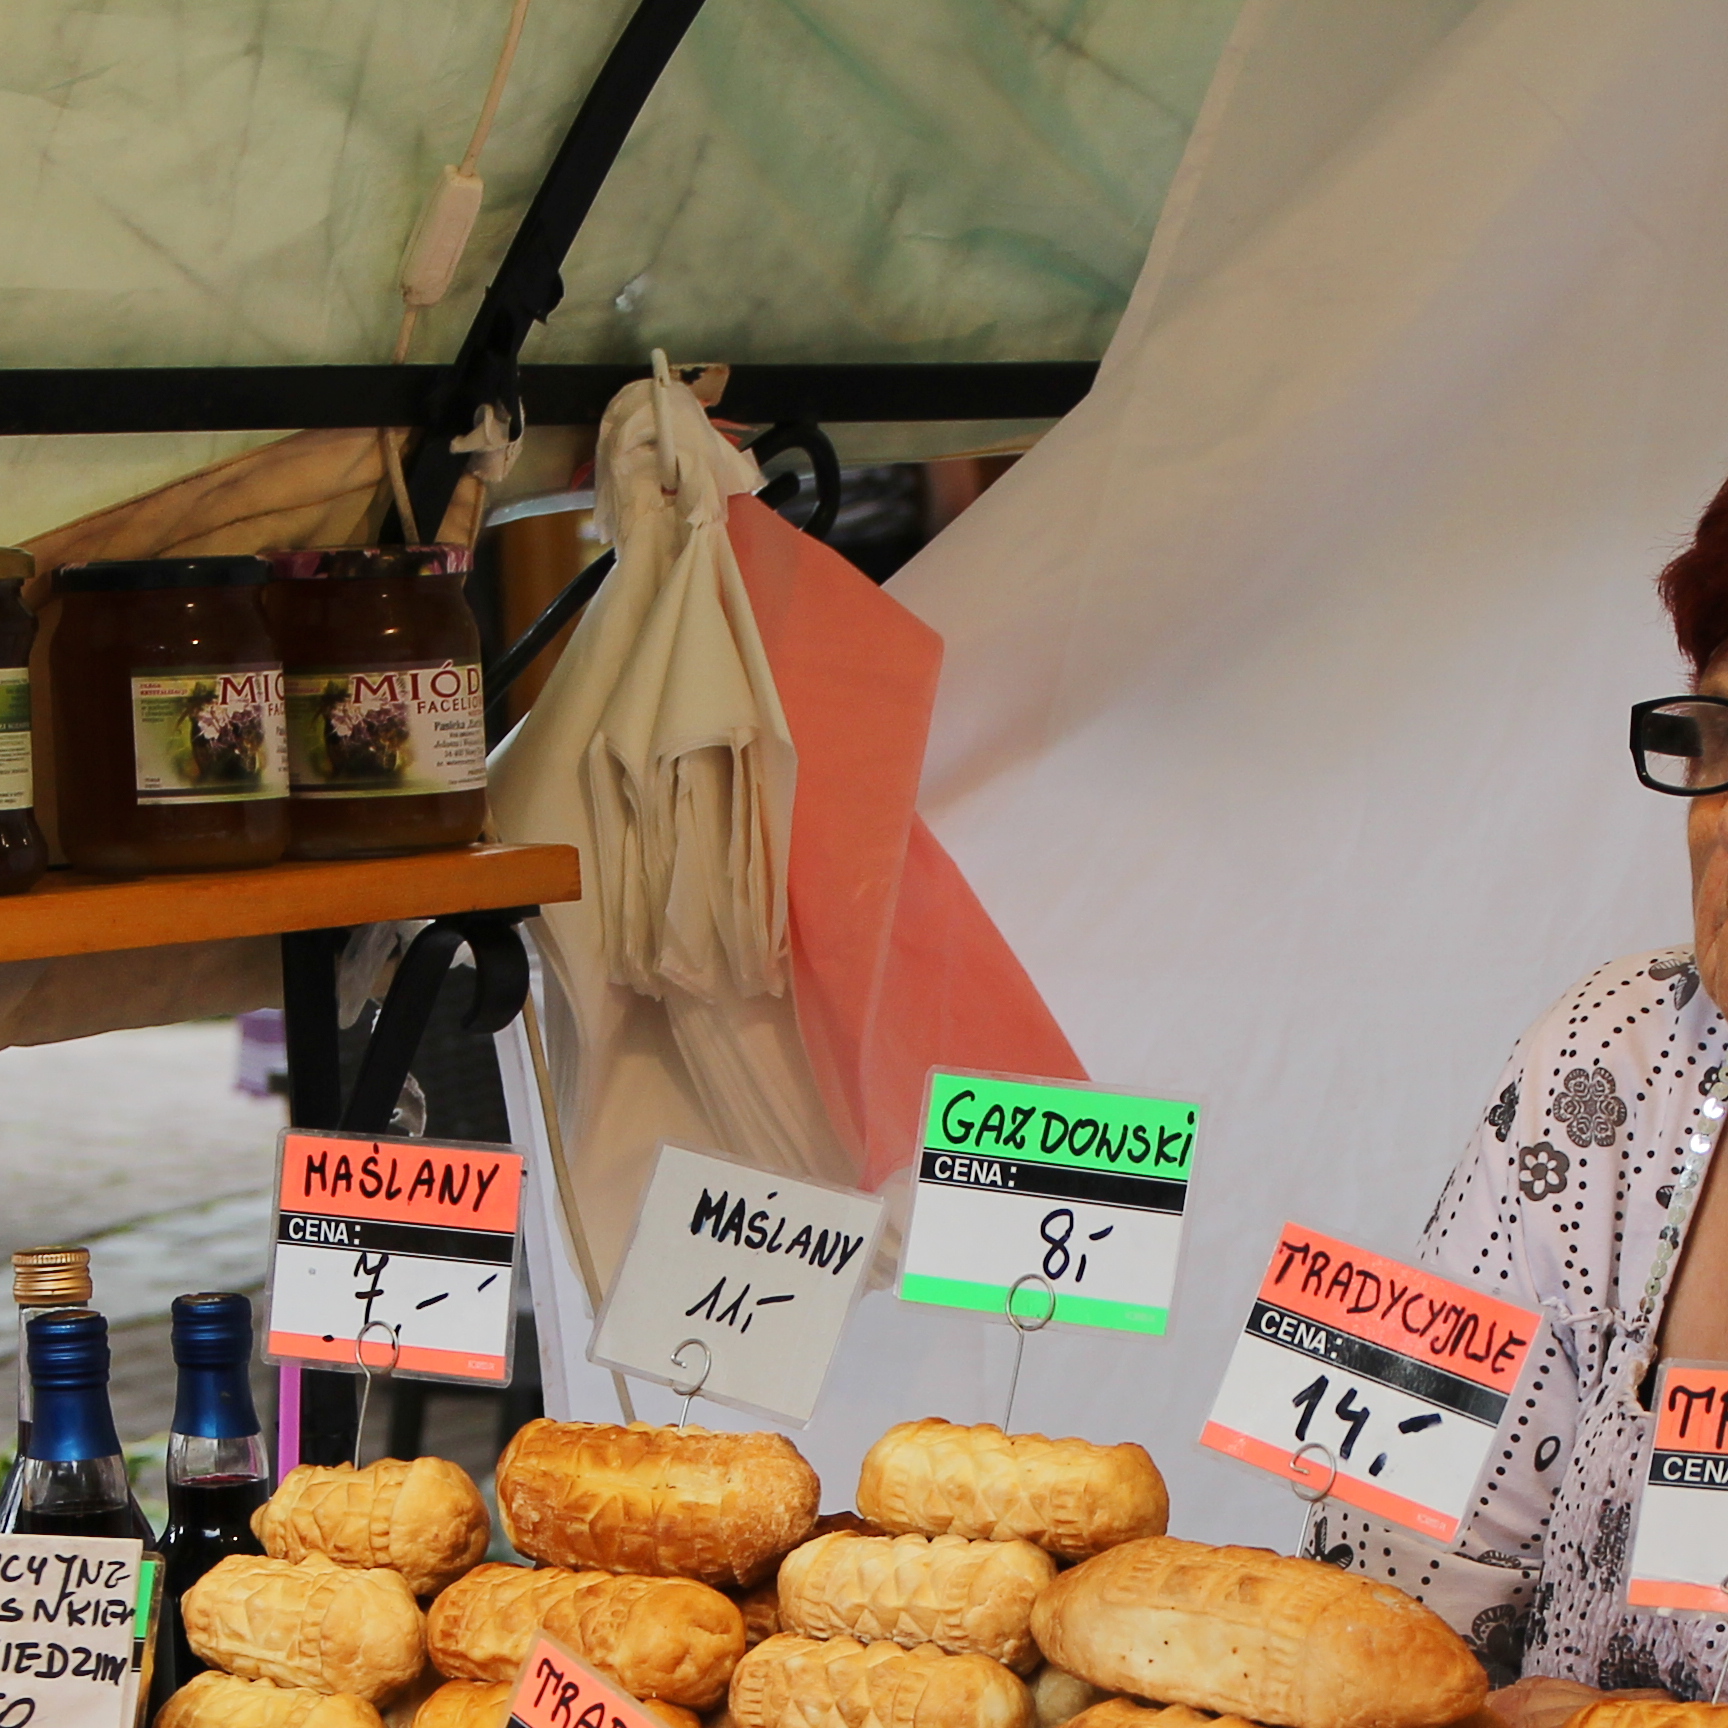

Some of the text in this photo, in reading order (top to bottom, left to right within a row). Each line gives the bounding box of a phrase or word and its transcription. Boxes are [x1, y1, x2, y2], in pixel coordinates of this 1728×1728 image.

[219, 672, 285, 706] MI
[351, 660, 480, 704] MIÓD
[303, 1142, 500, 1213] MAŚLANY
[933, 1154, 1018, 1188] CENA:
[287, 1218, 362, 1247] CENA:
[689, 1190, 864, 1275] MAŚLANY
[1273, 1238, 1527, 1375] TRADYCYJNE
[1258, 1309, 1344, 1361] CENA:
